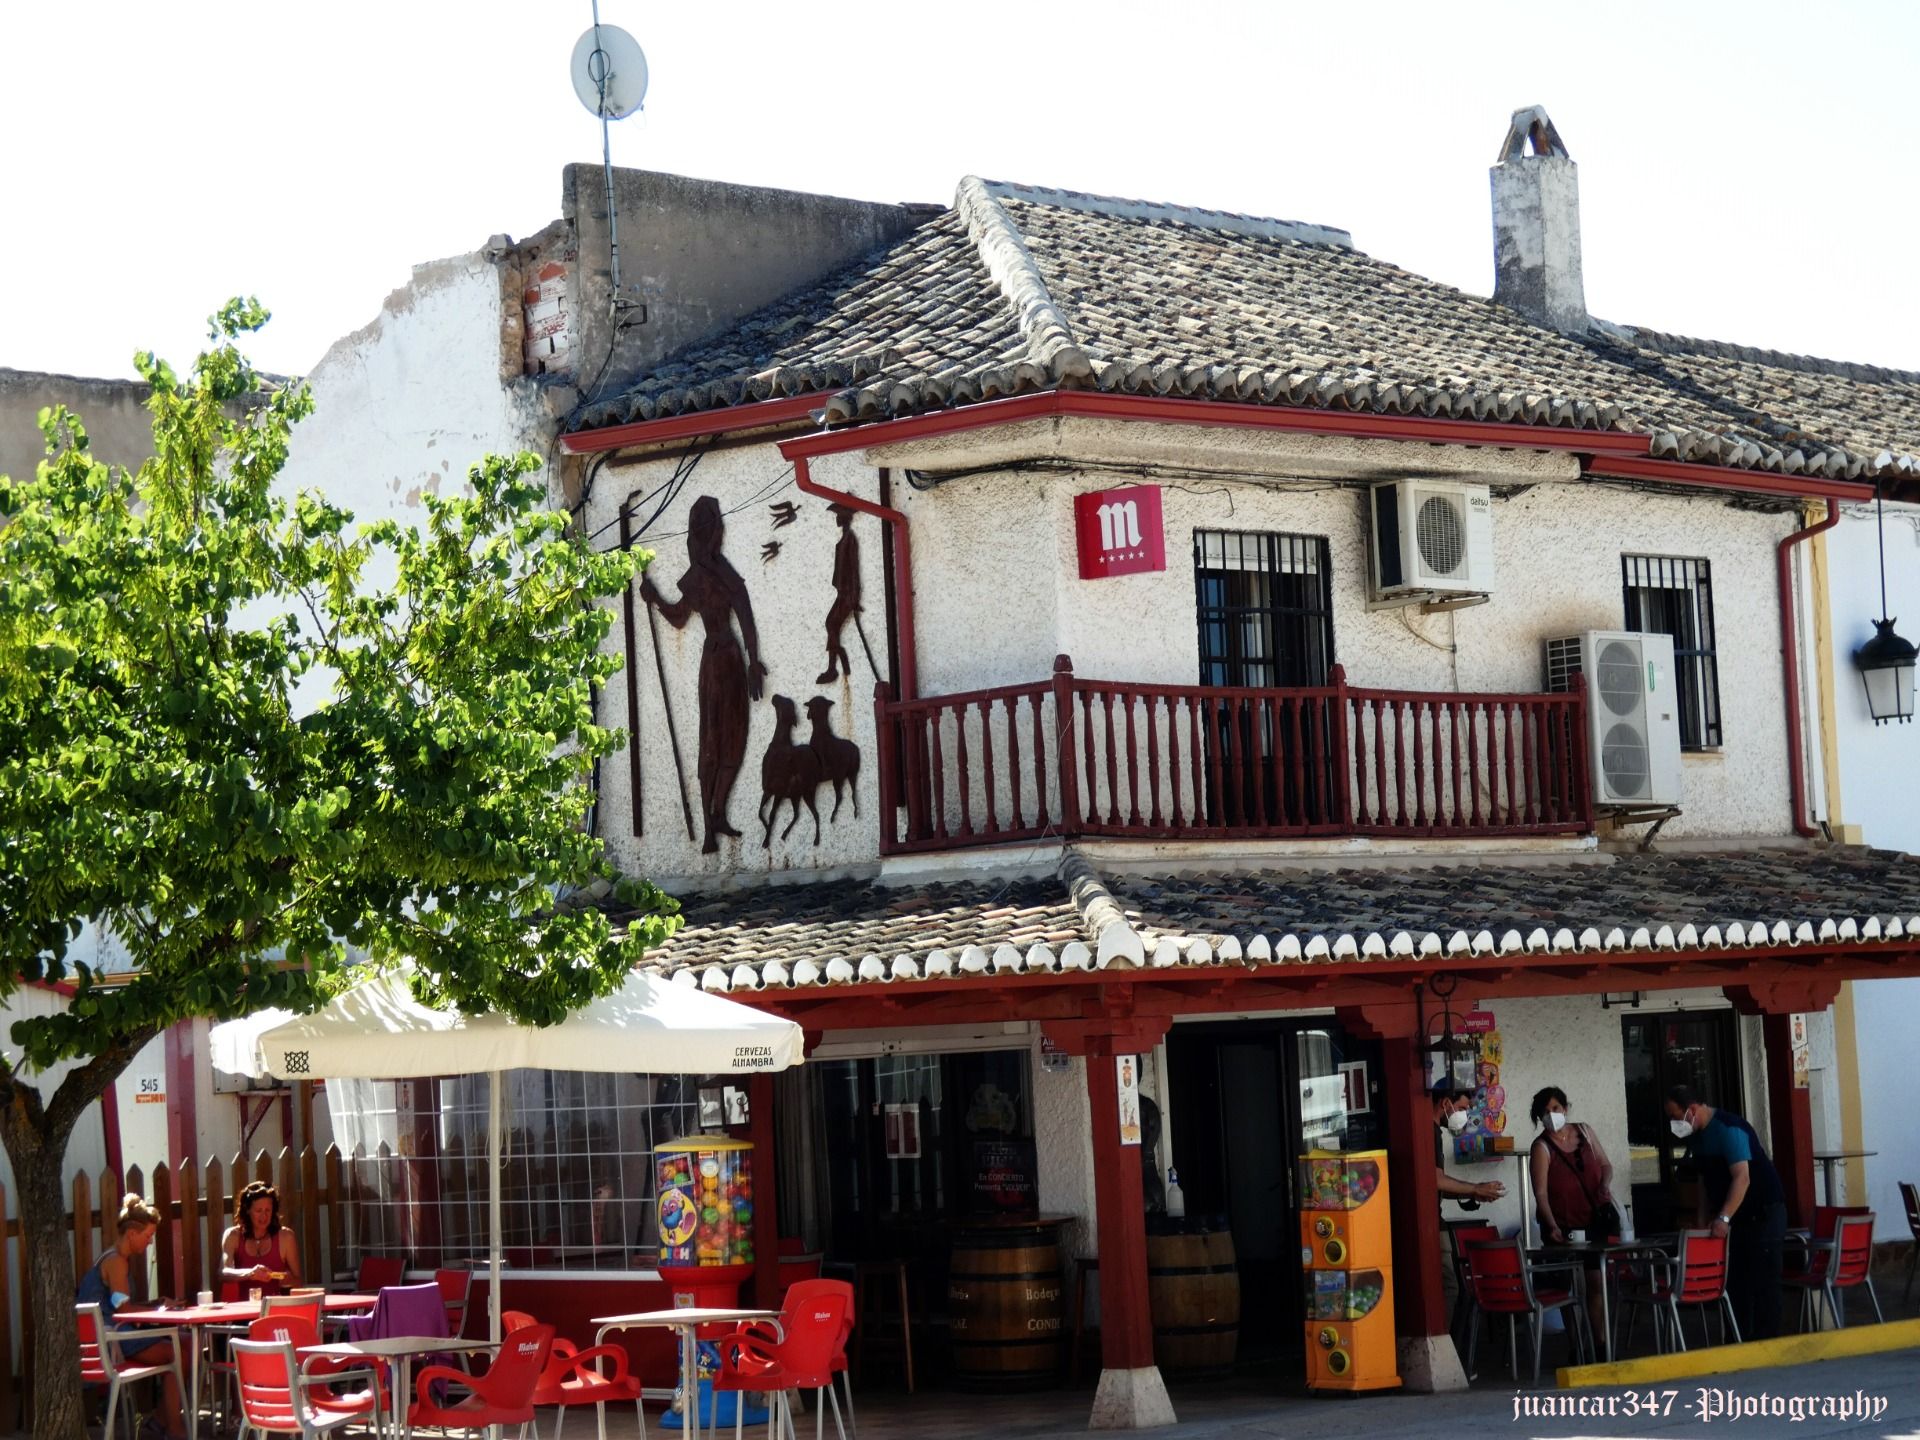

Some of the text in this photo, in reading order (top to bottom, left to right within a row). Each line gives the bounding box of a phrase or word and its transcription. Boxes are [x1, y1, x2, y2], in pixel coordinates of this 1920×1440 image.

[1096, 500, 1143, 551] m
[735, 1046, 772, 1057] CERVEZAS
[141, 1078, 158, 1092] 545
